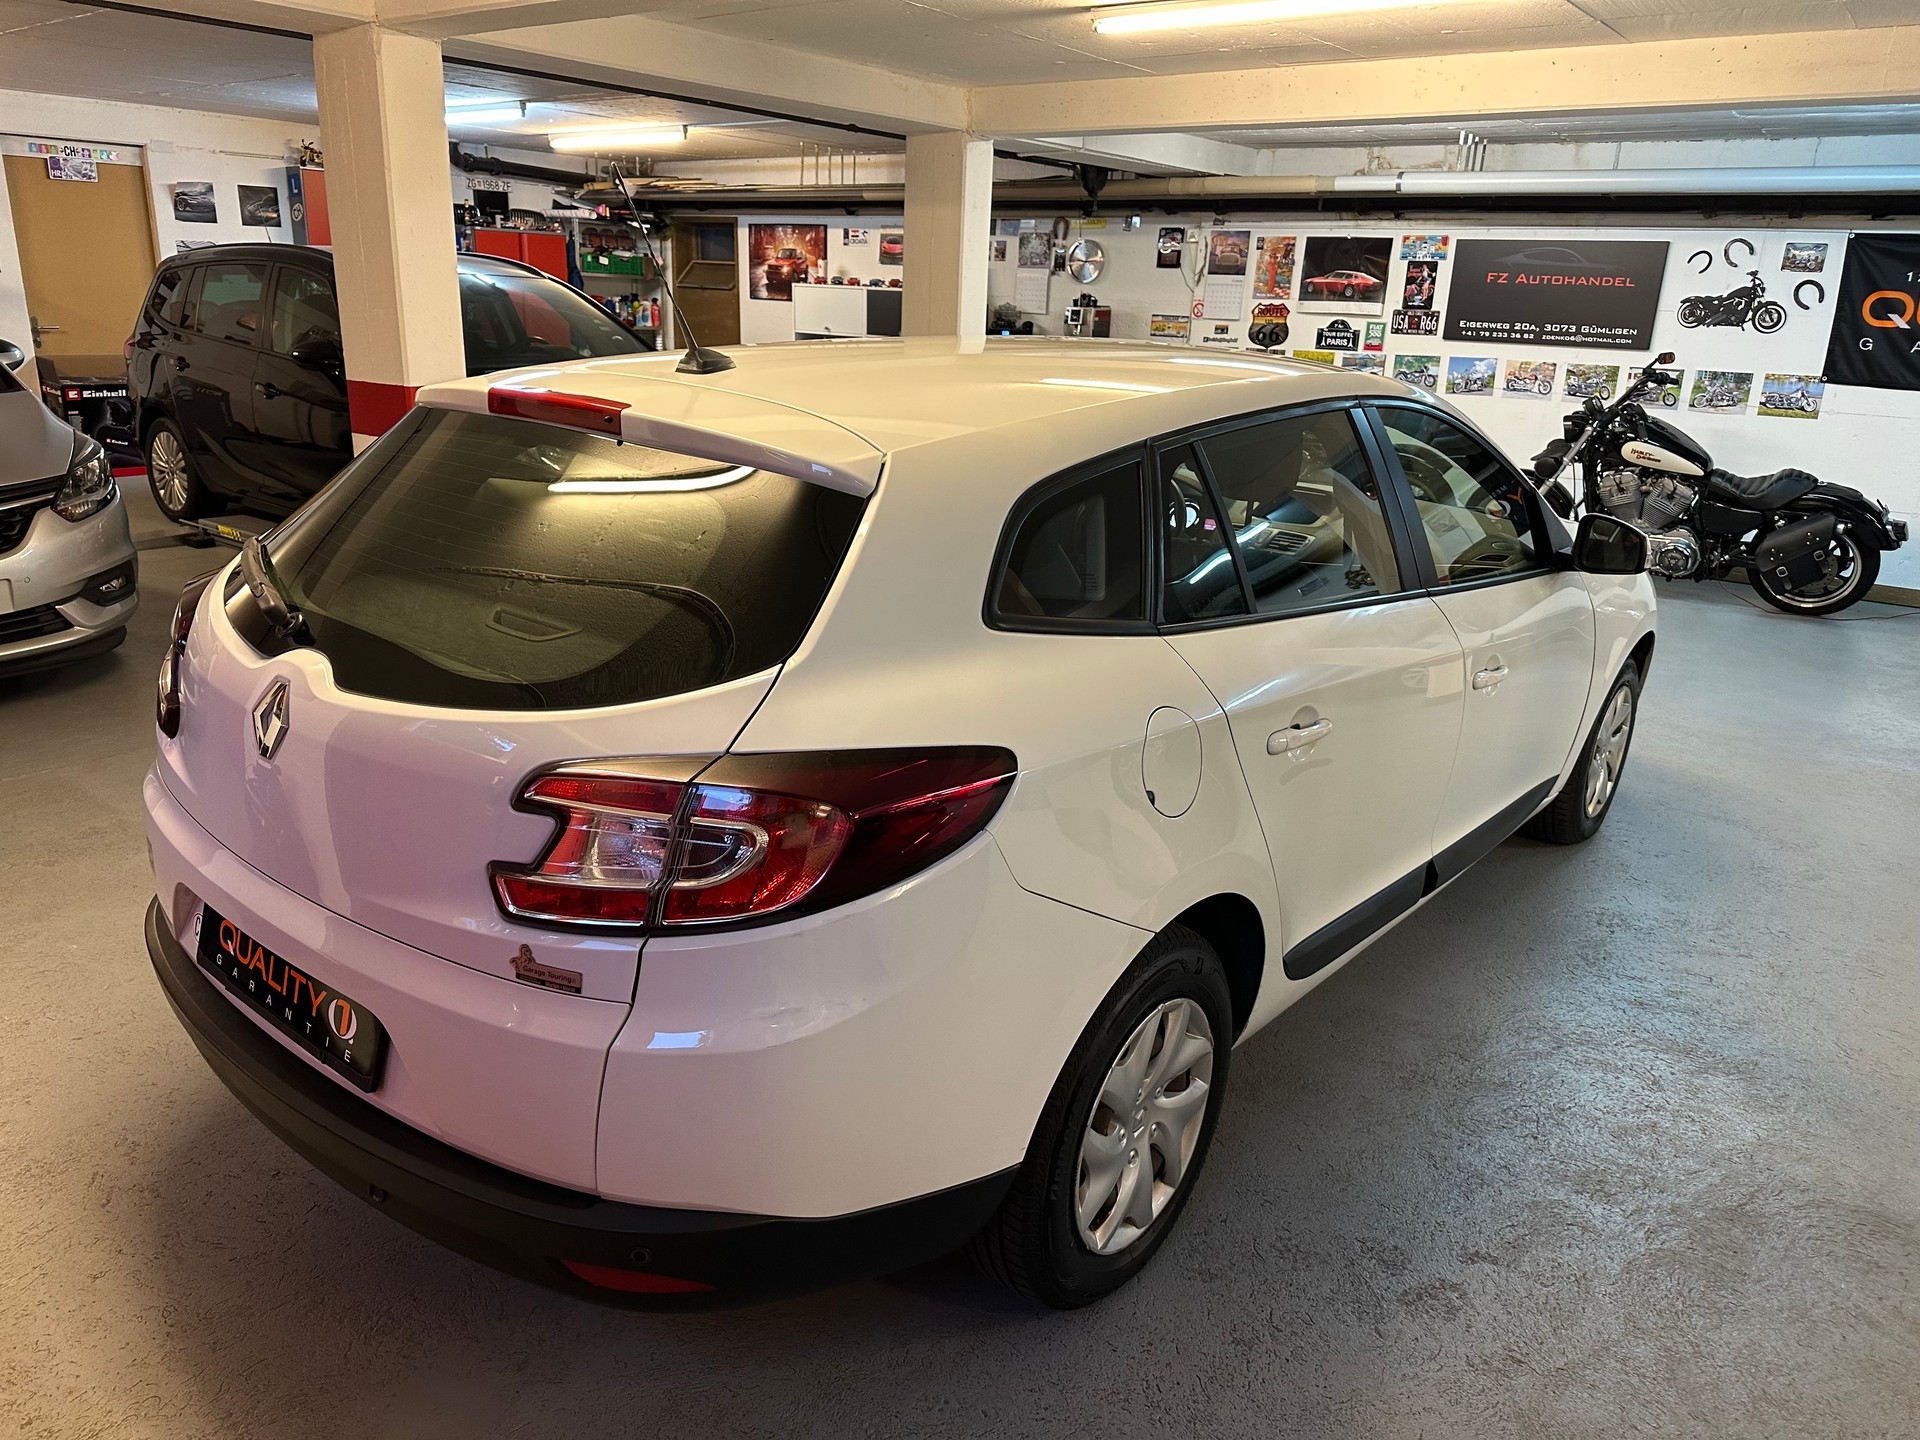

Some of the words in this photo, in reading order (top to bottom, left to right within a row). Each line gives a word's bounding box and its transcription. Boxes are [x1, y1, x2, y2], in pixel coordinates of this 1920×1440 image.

[64, 146, 76, 157] CH
[1487, 272, 1509, 284] FZ
[1257, 306, 1285, 316] ROUTE
[1862, 290, 1920, 329] Q
[1392, 314, 1409, 330] USA
[1420, 315, 1437, 331] R66
[1514, 322, 1540, 332] 20A,
[1543, 323, 1577, 333] 3073
[1256, 325, 1281, 343] 66
[1326, 338, 1348, 347] PARIS
[82, 389, 127, 398] Einhell
[219, 919, 327, 1017] QUALITY
[522, 965, 546, 977] Garage
[547, 970, 572, 984] Touring
[216, 953, 352, 1063] GARANTIE
